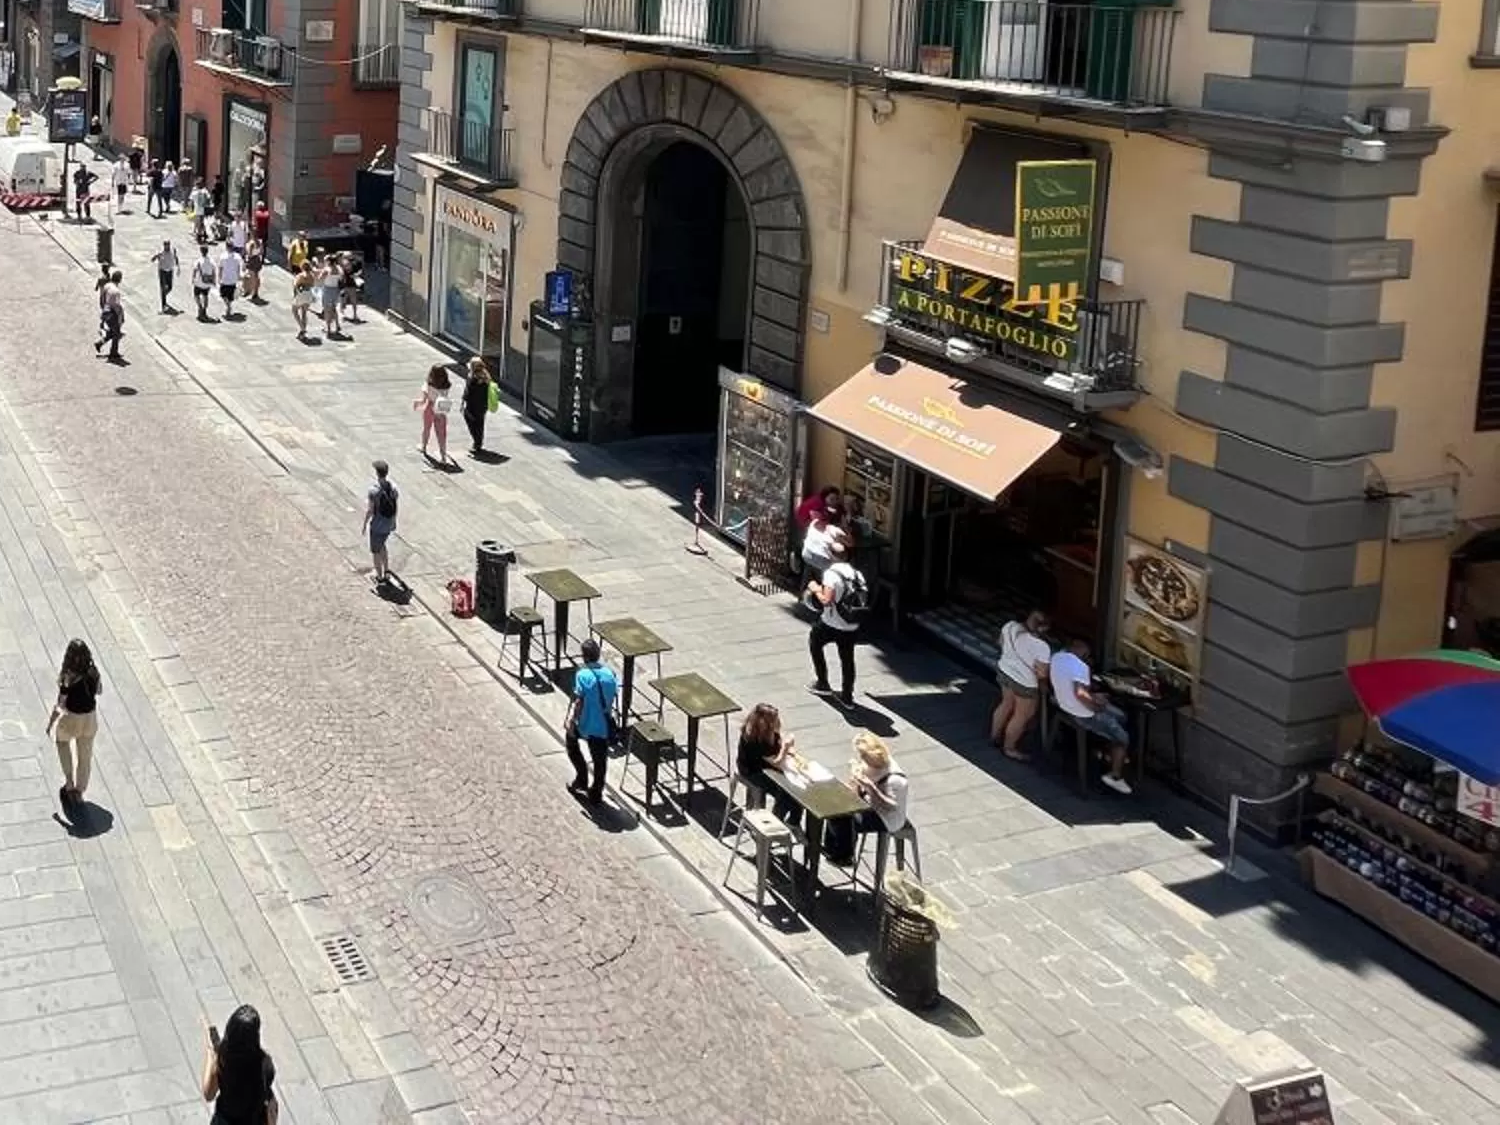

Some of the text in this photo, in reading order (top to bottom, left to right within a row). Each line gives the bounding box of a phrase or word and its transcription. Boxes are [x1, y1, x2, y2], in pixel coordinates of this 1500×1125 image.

[1022, 205, 1091, 222] PASSIONE
[1031, 226, 1045, 239] DI
[898, 253, 1079, 332] PIZZE
[898, 291, 1068, 359] A PORTAFOGLIO
